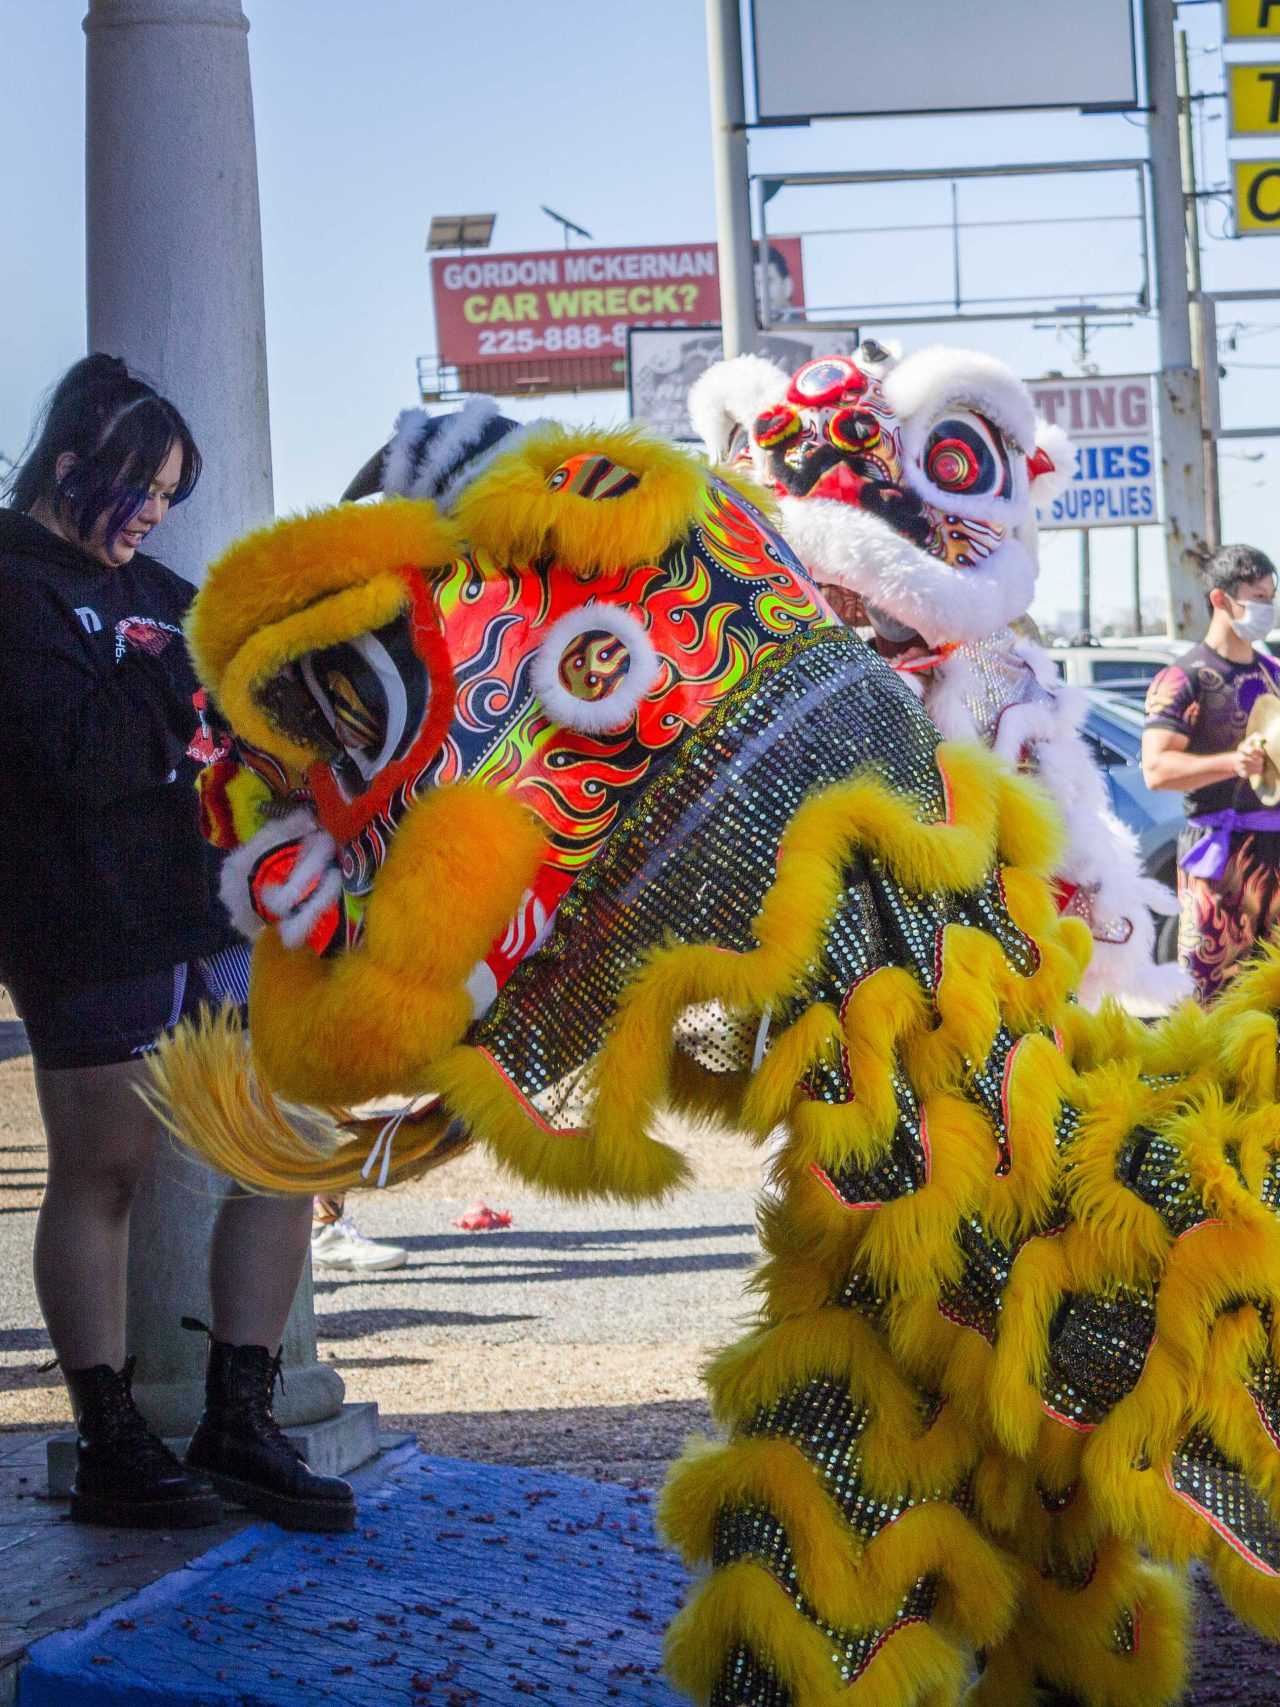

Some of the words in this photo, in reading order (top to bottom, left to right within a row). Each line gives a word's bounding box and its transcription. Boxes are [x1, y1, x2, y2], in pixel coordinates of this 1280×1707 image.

[443, 259, 558, 290] GORDON
[564, 251, 715, 284] MCKERNAN
[464, 293, 540, 323] CAR
[546, 284, 698, 319] WRECK?
[1052, 486, 1153, 520] SUPPLIES
